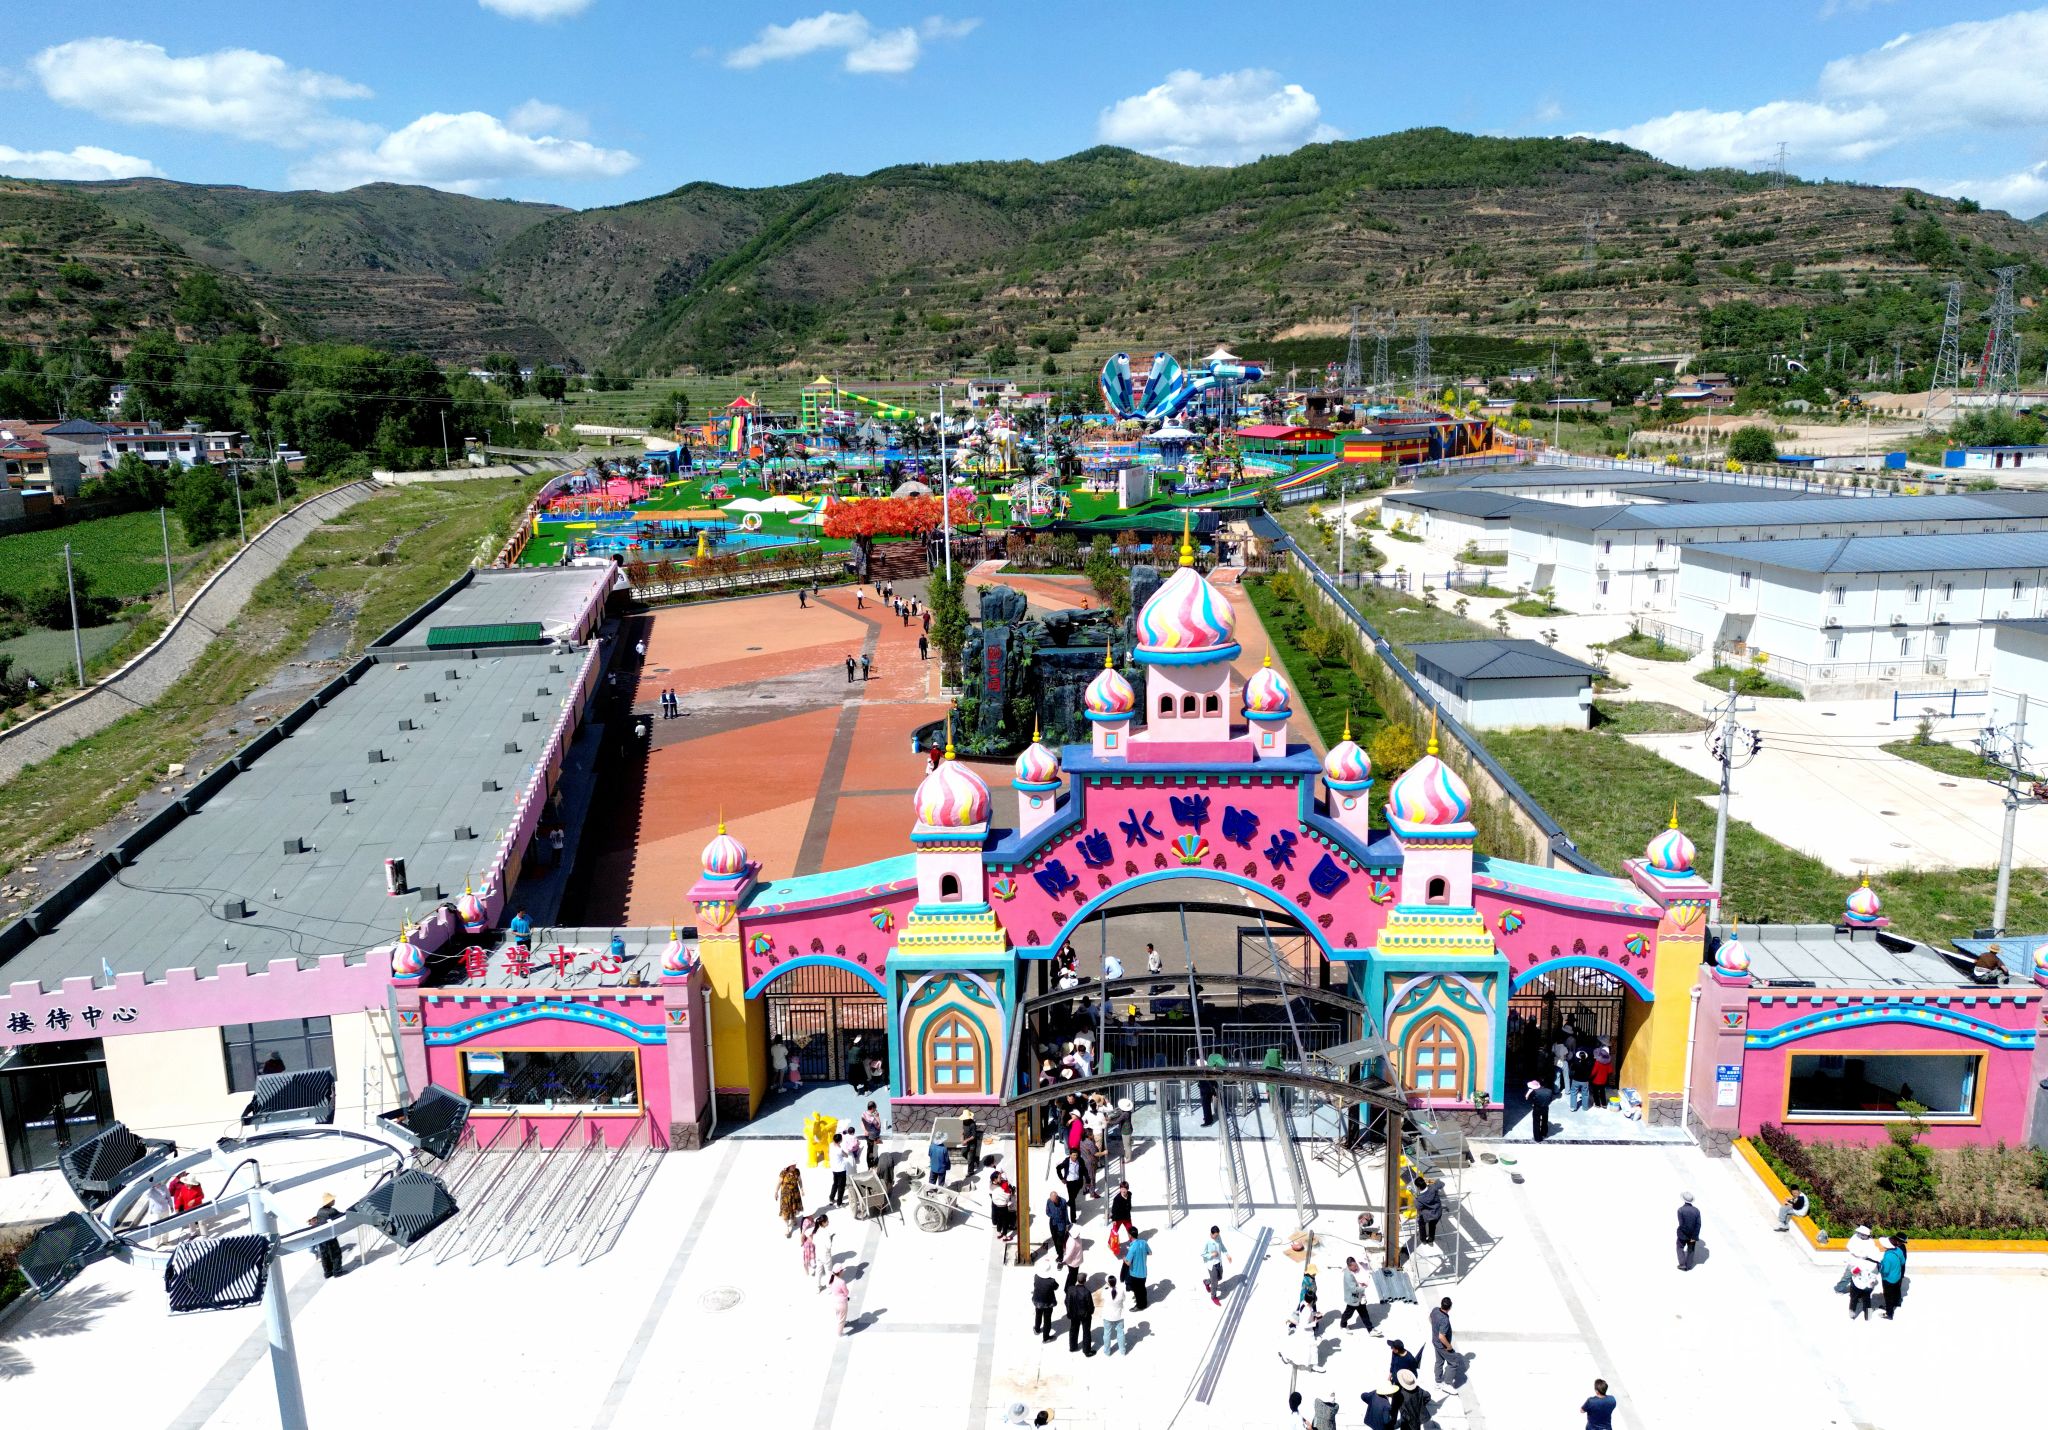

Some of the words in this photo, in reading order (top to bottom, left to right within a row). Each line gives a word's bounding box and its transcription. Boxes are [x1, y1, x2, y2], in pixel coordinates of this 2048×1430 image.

[458, 944, 623, 979] 售票中心
[6, 1005, 138, 1034] 接待中心
